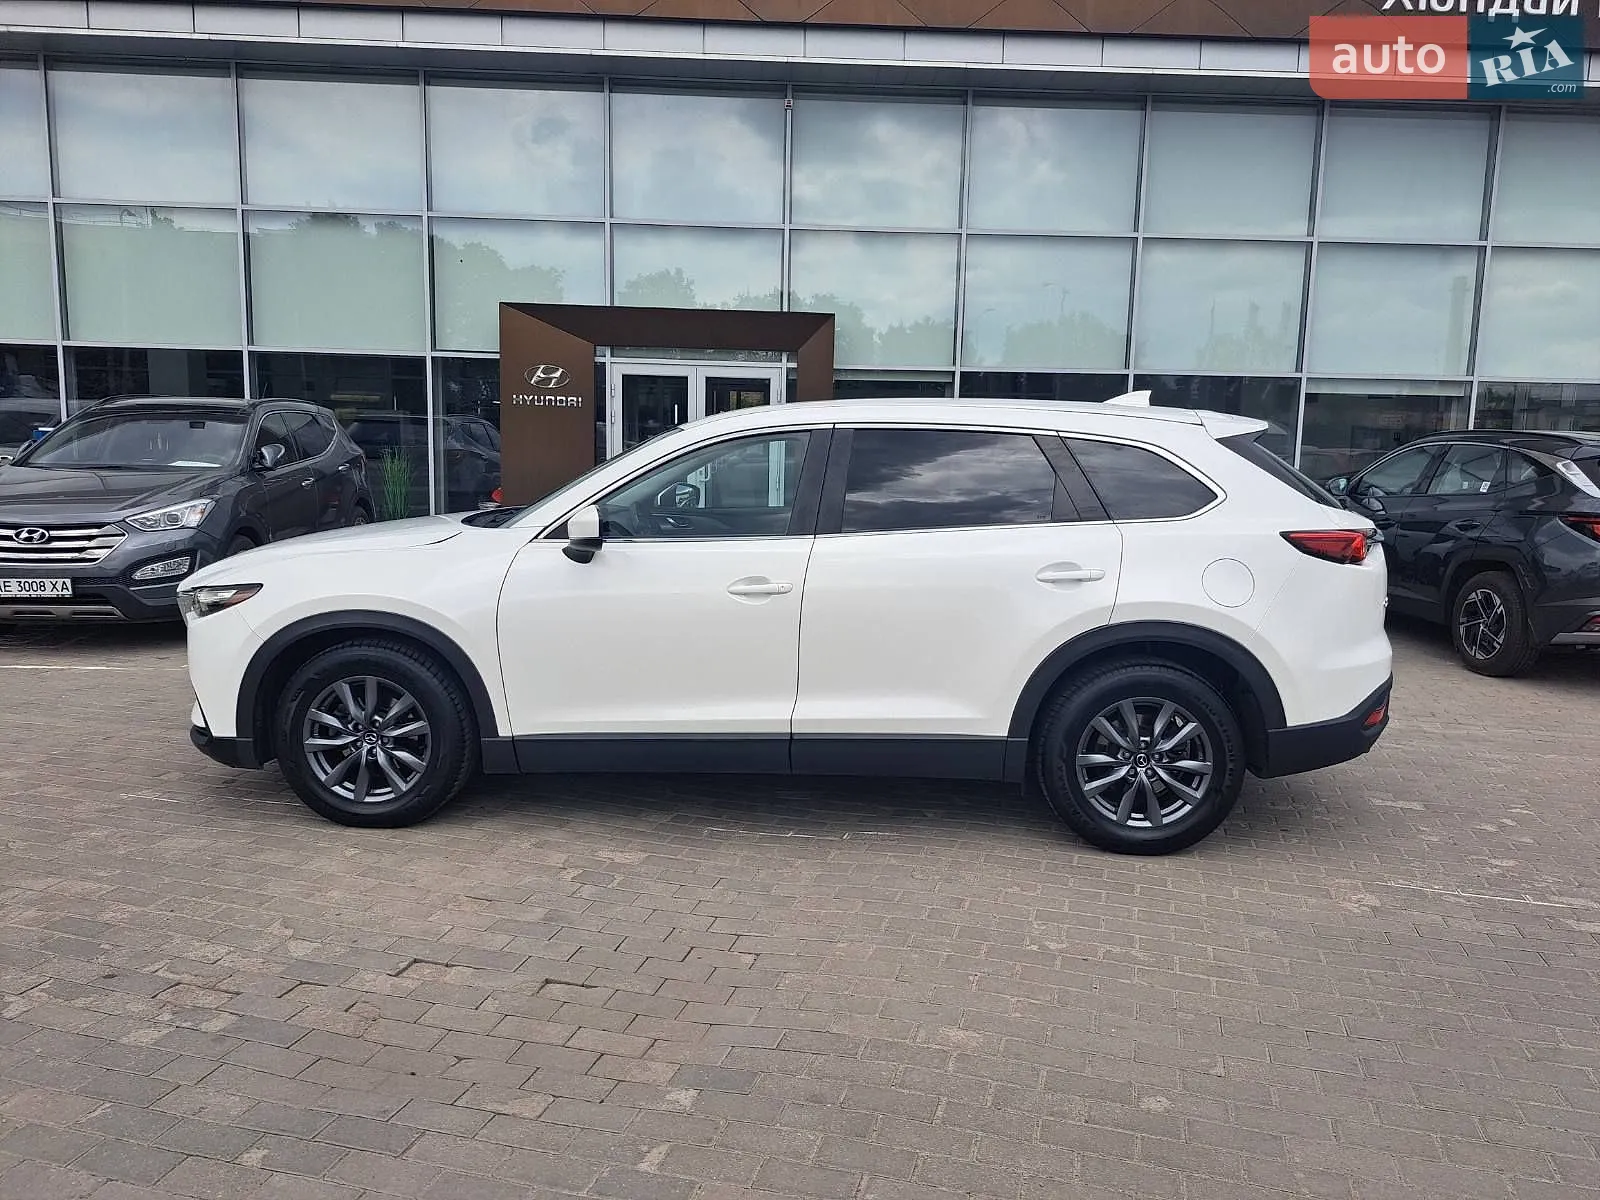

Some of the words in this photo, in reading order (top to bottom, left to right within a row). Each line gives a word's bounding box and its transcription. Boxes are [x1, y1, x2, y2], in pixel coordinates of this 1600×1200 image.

[512, 394, 582, 407] HYUNDAI
[16, 580, 46, 592] 3008
[49, 580, 70, 592] XA
